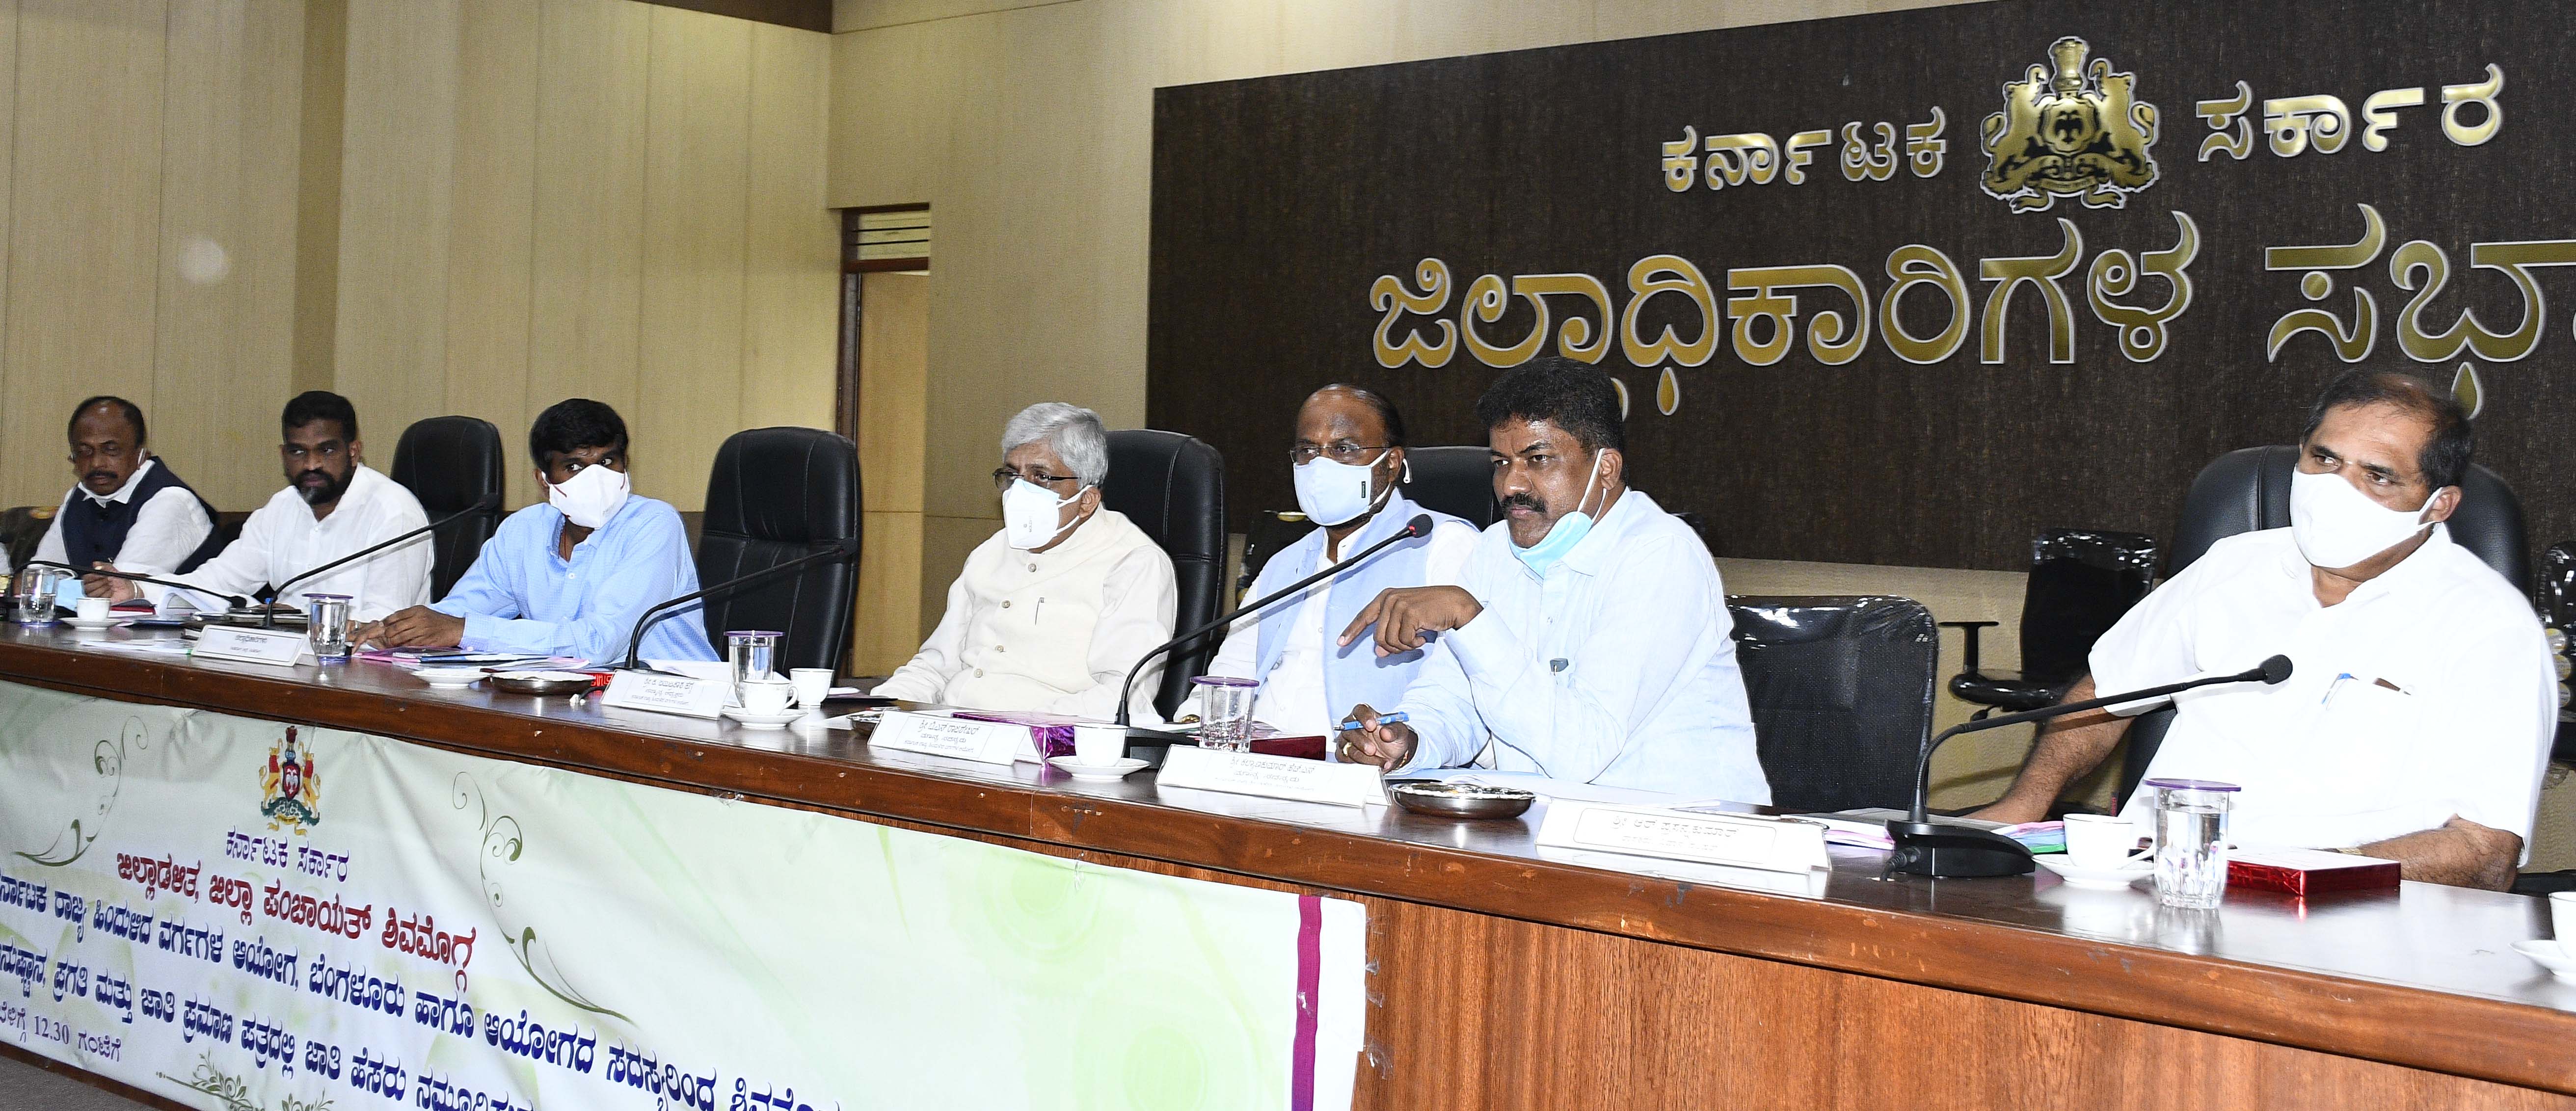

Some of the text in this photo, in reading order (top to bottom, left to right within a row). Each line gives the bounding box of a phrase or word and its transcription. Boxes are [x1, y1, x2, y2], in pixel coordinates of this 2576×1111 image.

[1661, 63, 2504, 193] ಕರ್ನಾಟಕ ಸರ್ಕಾರ
[1368, 210, 2201, 418] ಜಿಲ್ಾಧಿಕಾರಿಗಳ
[226, 825, 349, 882] ಕರ್ನಾಟಕ ಸರ್ಕಾರ
[0, 873, 47, 913] ರ್ನಾಟಕ
[54, 890, 87, 943] ರಾಜ್ಯ
[93, 899, 154, 944] ಹಿಂದುಳಿದ
[159, 914, 224, 964] ವರ್ಗಗಳ
[233, 935, 299, 992] ಆಯೋಗ,
[309, 953, 405, 1018] ಬೆಂಗಳೂರು
[415, 990, 475, 1036] ಹಾಗೂ
[484, 1009, 597, 1074] ಆಯೋಗದ
[606, 1038, 717, 1111] ಸದಸ್ಯರಿಂದ
[209, 874, 253, 926] ಜಿಲ್ಲಾ
[264, 877, 372, 940] ಪಂಚಾಯತ್
[381, 907, 476, 993] ಶಿವಮೊಗ್ಗ
[33, 1015, 70, 1045] 12.30
[78, 1029, 122, 1063] ಗಂಟೆಗೆ
[53, 954, 88, 1002] ಪ್ರಗತಿ
[95, 968, 134, 1025] ಮತ್ತು
[141, 987, 176, 1024] ಜಾತಿ
[184, 993, 233, 1044] ಪ್ರಮಾಣ
[241, 1012, 295, 1080] ಪತ್ರದಲ್ಲಿ
[305, 1039, 341, 1080] ಜಾತಿ
[350, 1047, 407, 1101] ಹೆಸರು
